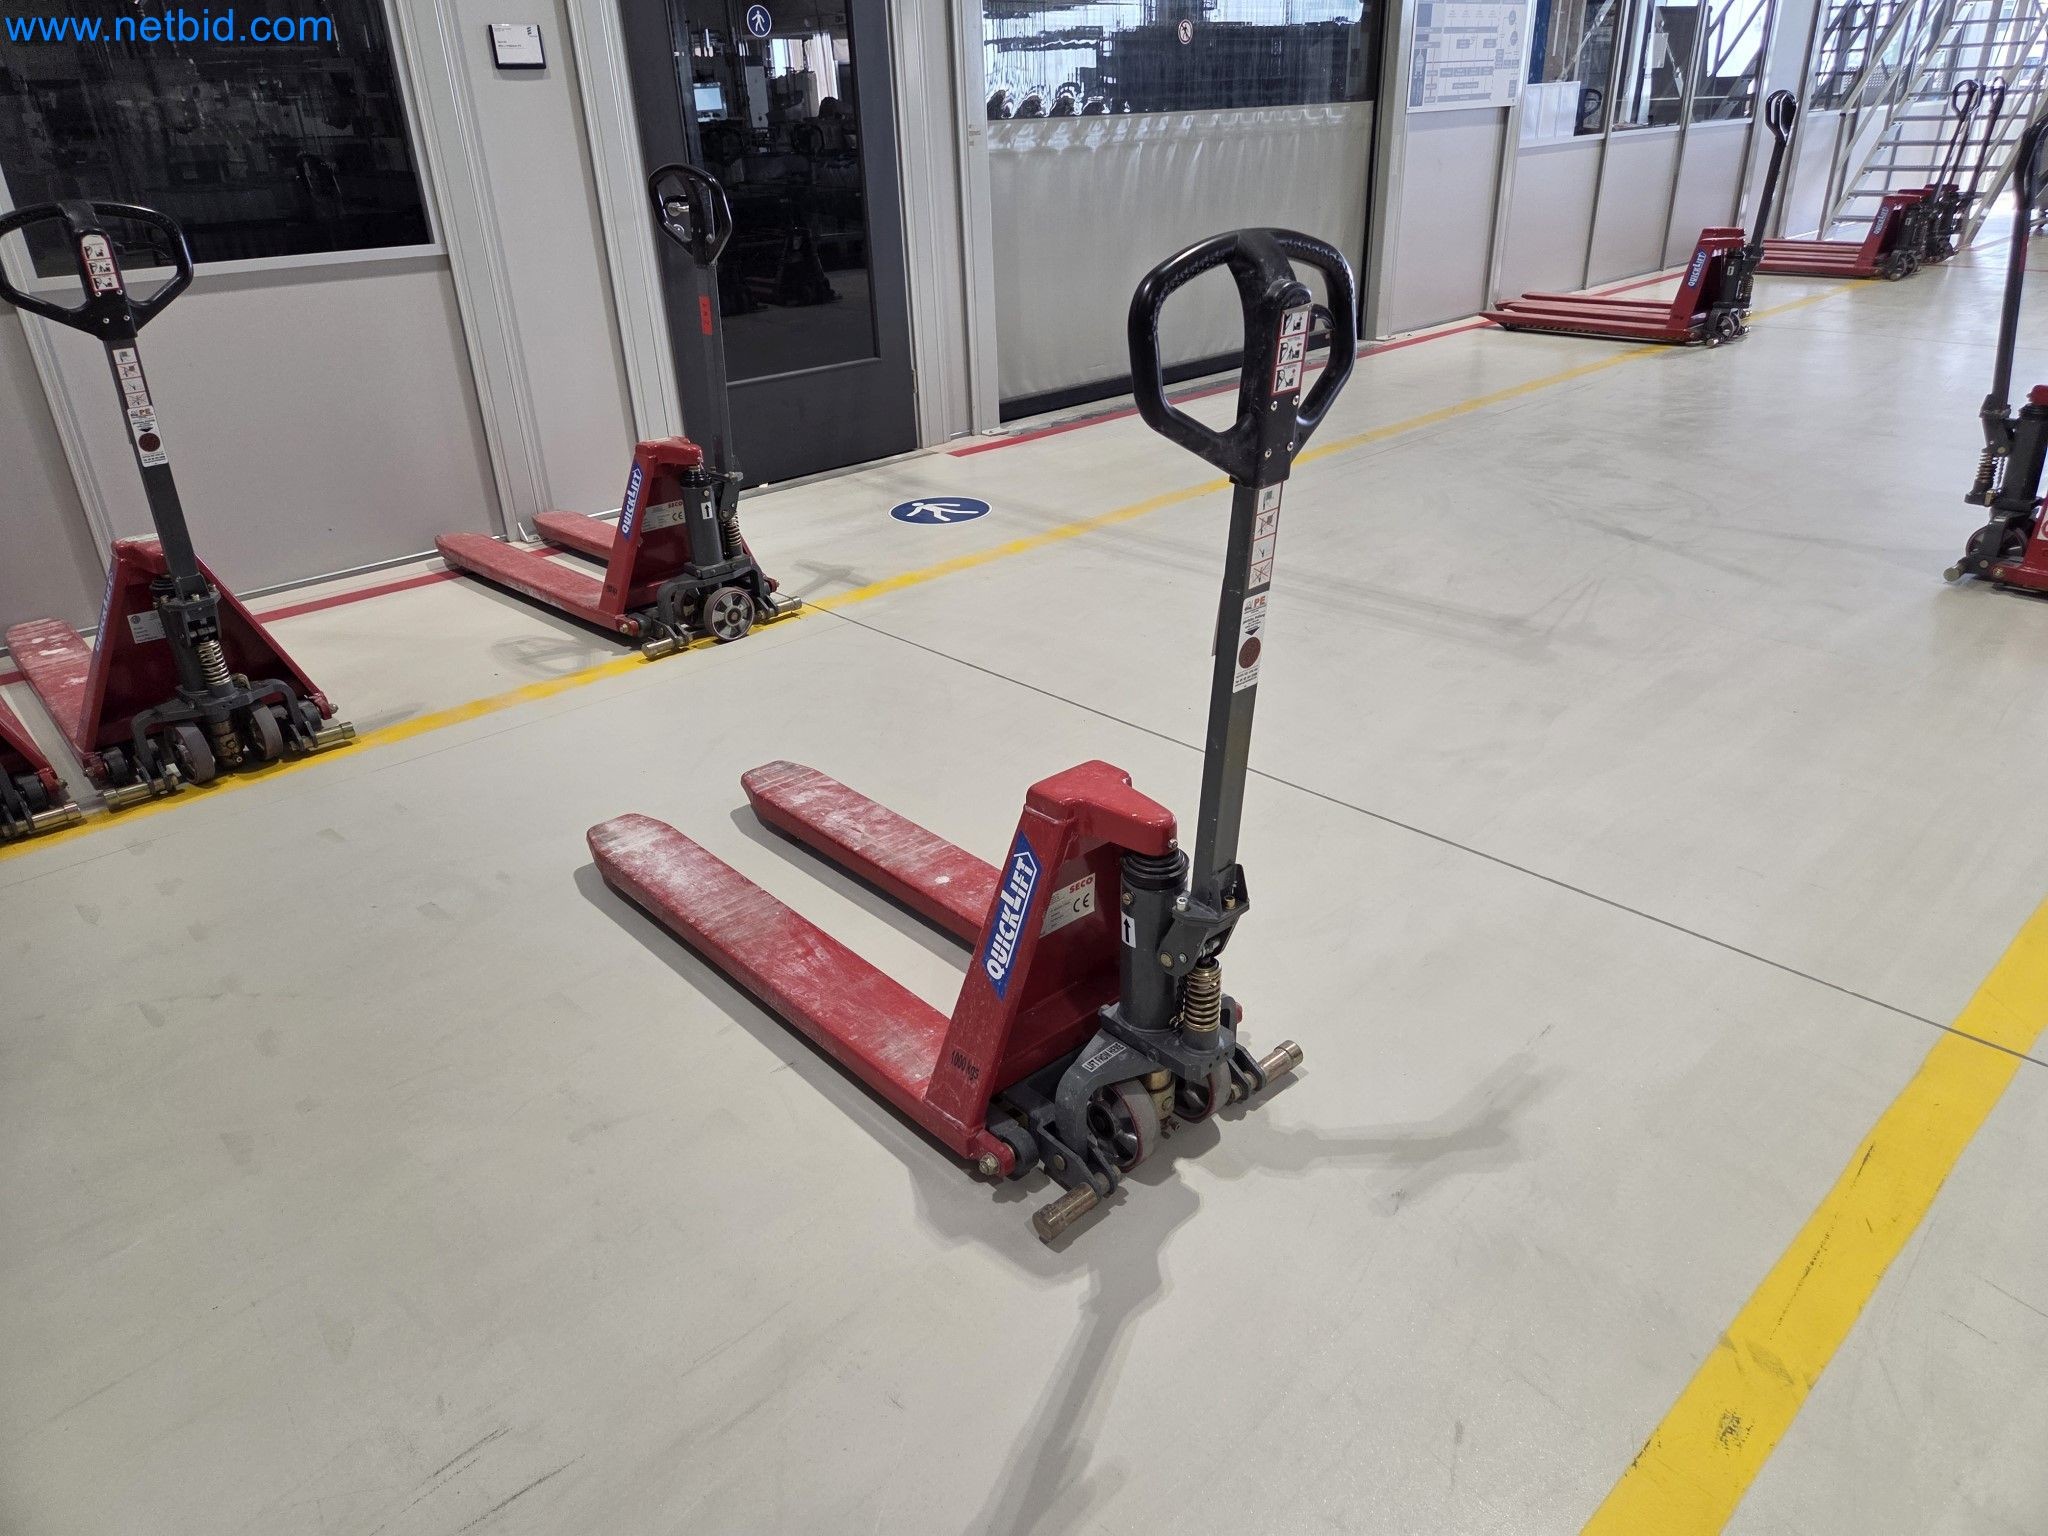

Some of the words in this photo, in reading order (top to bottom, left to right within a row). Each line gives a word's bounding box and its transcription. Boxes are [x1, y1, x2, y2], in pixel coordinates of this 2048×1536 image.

[622, 470, 642, 534] QUICKLIFT
[1069, 876, 1094, 894] SECO
[986, 855, 1035, 980] QUICKLIFT
